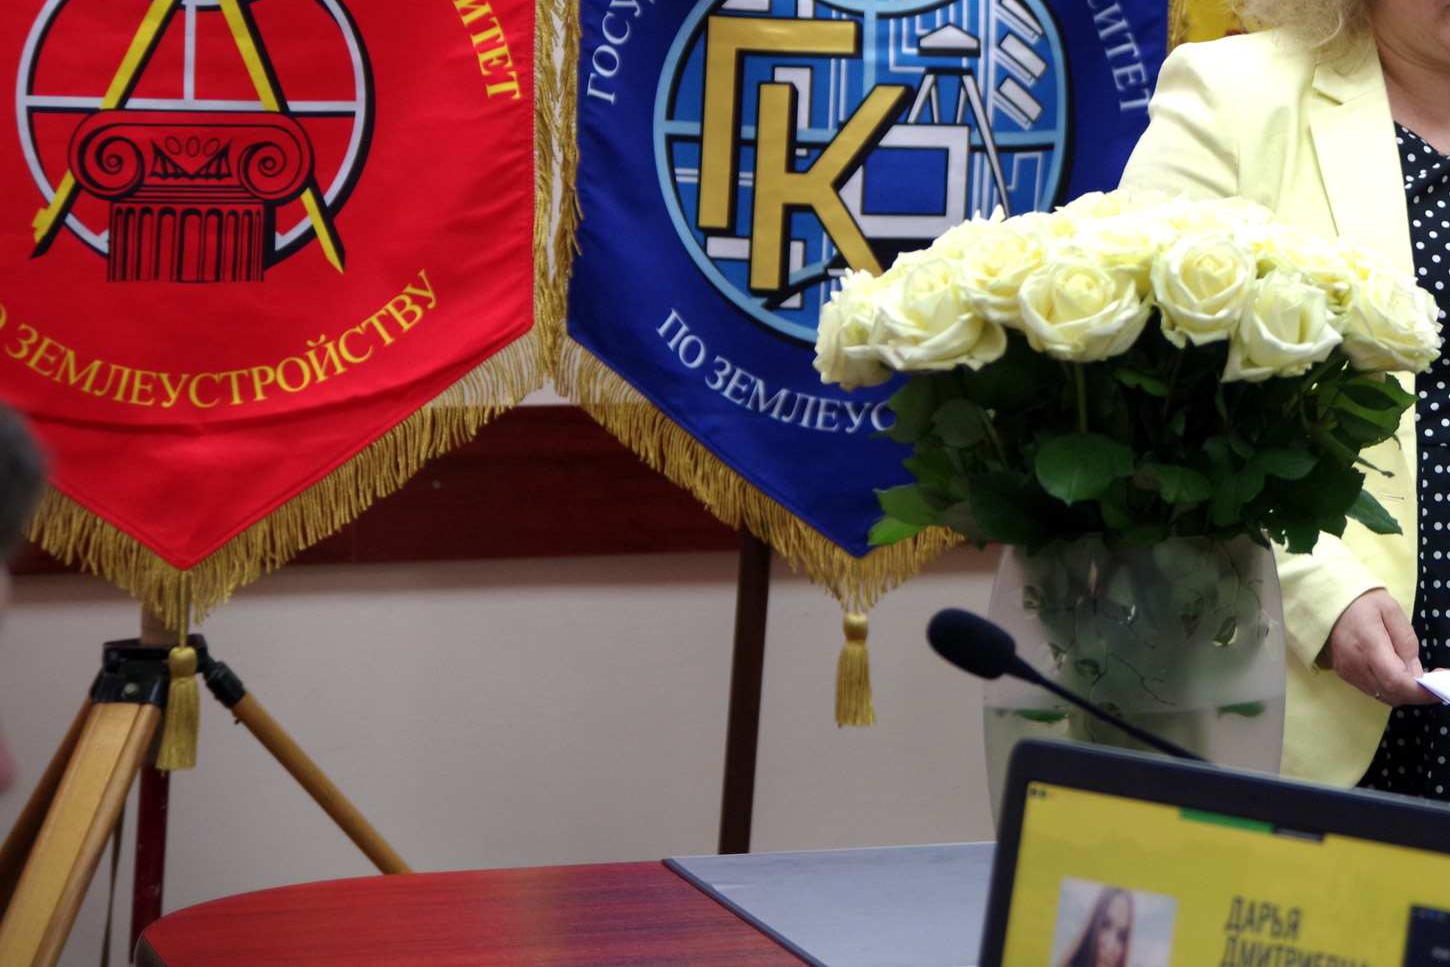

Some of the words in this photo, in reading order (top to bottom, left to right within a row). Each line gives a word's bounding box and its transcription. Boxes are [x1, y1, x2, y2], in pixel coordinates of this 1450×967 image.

[4, 269, 437, 408] ЗЕМЛЕУСТРОЙСТВУ
[656, 307, 706, 369] ПО
[1225, 895, 1304, 940] ДАРЬЯ
